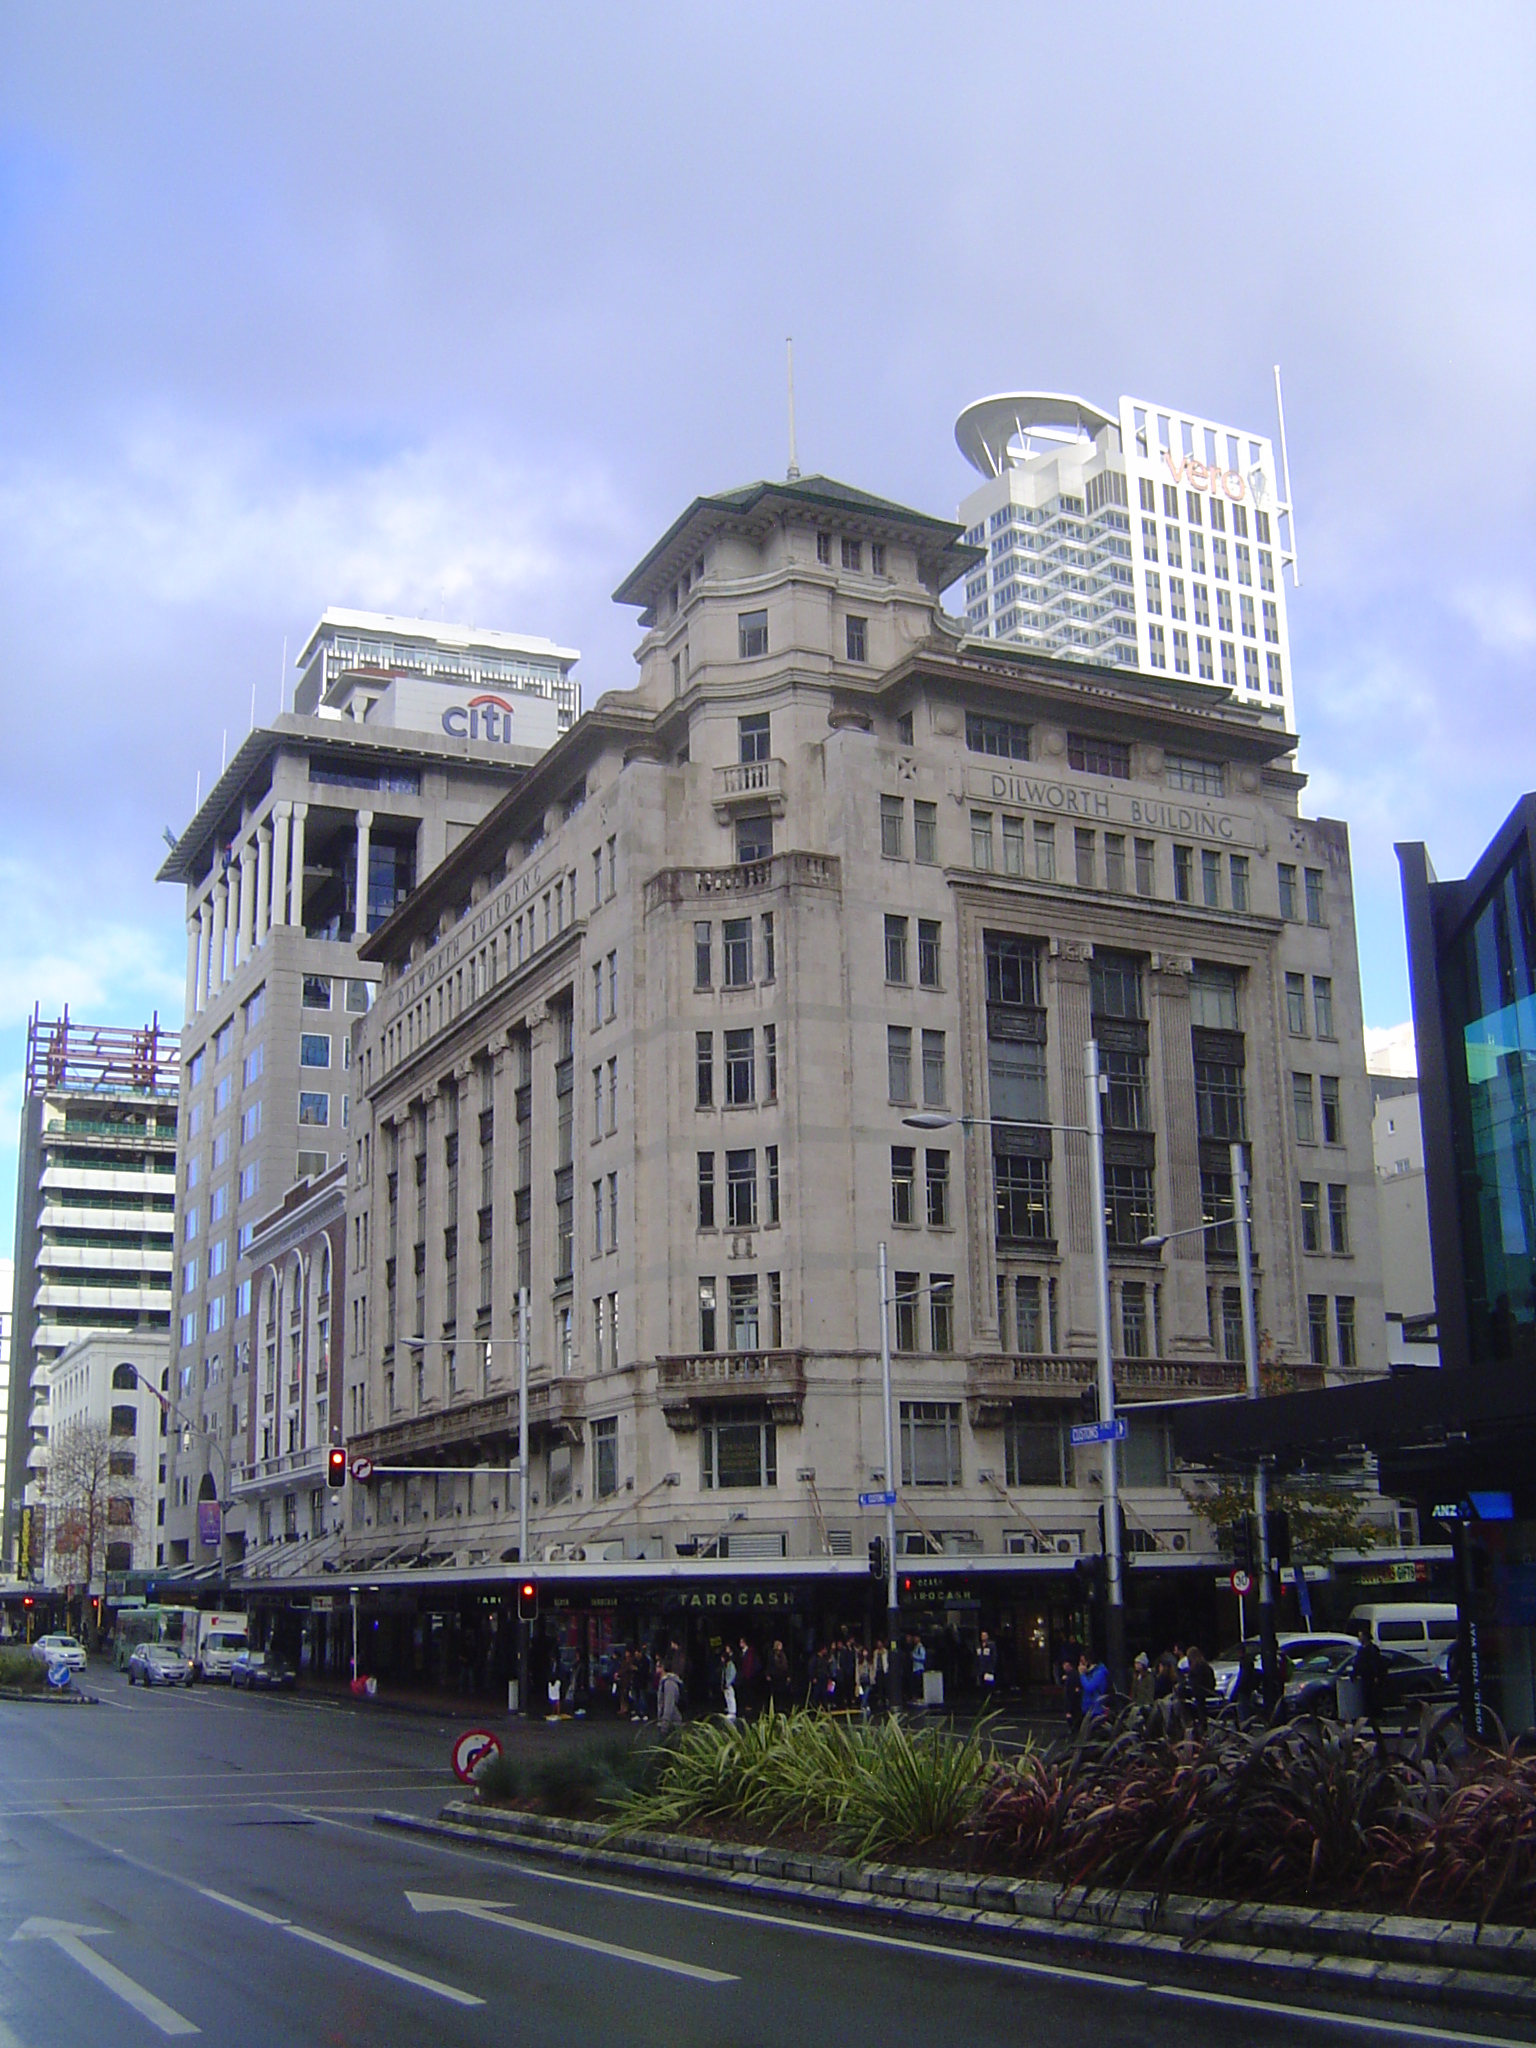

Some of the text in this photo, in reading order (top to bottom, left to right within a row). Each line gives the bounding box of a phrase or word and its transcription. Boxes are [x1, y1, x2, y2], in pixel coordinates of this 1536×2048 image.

[441, 698, 513, 744] citi
[991, 774, 1233, 838] DILWORTH BUILDING
[471, 864, 541, 942] BUILDING
[1431, 1504, 1458, 1517] ANZ
[1235, 1575, 1248, 1587] 30
[679, 1592, 795, 1606] TAROCASH
[1469, 1621, 1477, 1647] WAY
